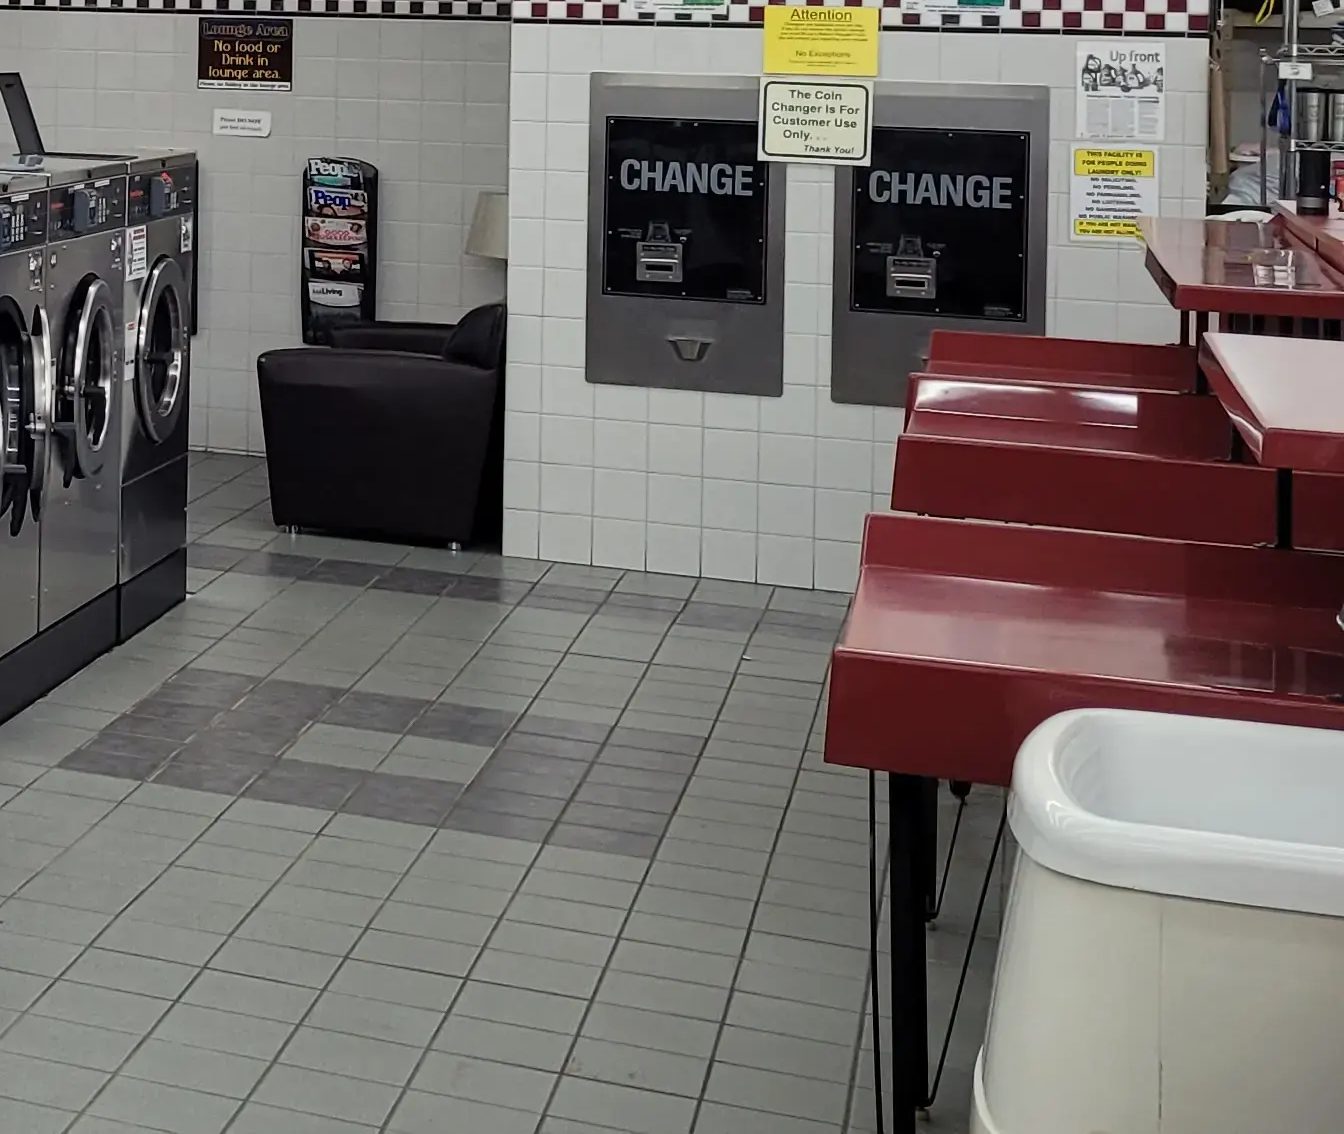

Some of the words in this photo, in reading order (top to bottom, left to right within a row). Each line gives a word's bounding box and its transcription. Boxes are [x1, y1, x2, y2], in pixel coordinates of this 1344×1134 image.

[790, 9, 852, 21] Attention
[202, 22, 253, 38] Lounge
[256, 23, 288, 37] Area
[214, 40, 231, 52] No
[235, 40, 262, 53] food
[266, 43, 281, 54] or
[222, 54, 254, 66] Drink
[257, 54, 268, 66] in
[1110, 50, 1126, 64] Up
[1128, 50, 1160, 62] front
[208, 67, 248, 80] lounge
[252, 69, 281, 79] area.
[789, 90, 811, 99] The
[815, 91, 842, 100] Coin
[772, 102, 822, 114] Changer
[826, 105, 835, 114] Is
[840, 106, 860, 114] For
[773, 116, 830, 127] Customer
[834, 119, 857, 128] Use
[804, 145, 830, 153] Thank
[834, 146, 854, 154] You!
[620, 159, 754, 196] CHANGE
[869, 170, 1013, 209] CHANGE
[322, 288, 342, 296] Living
